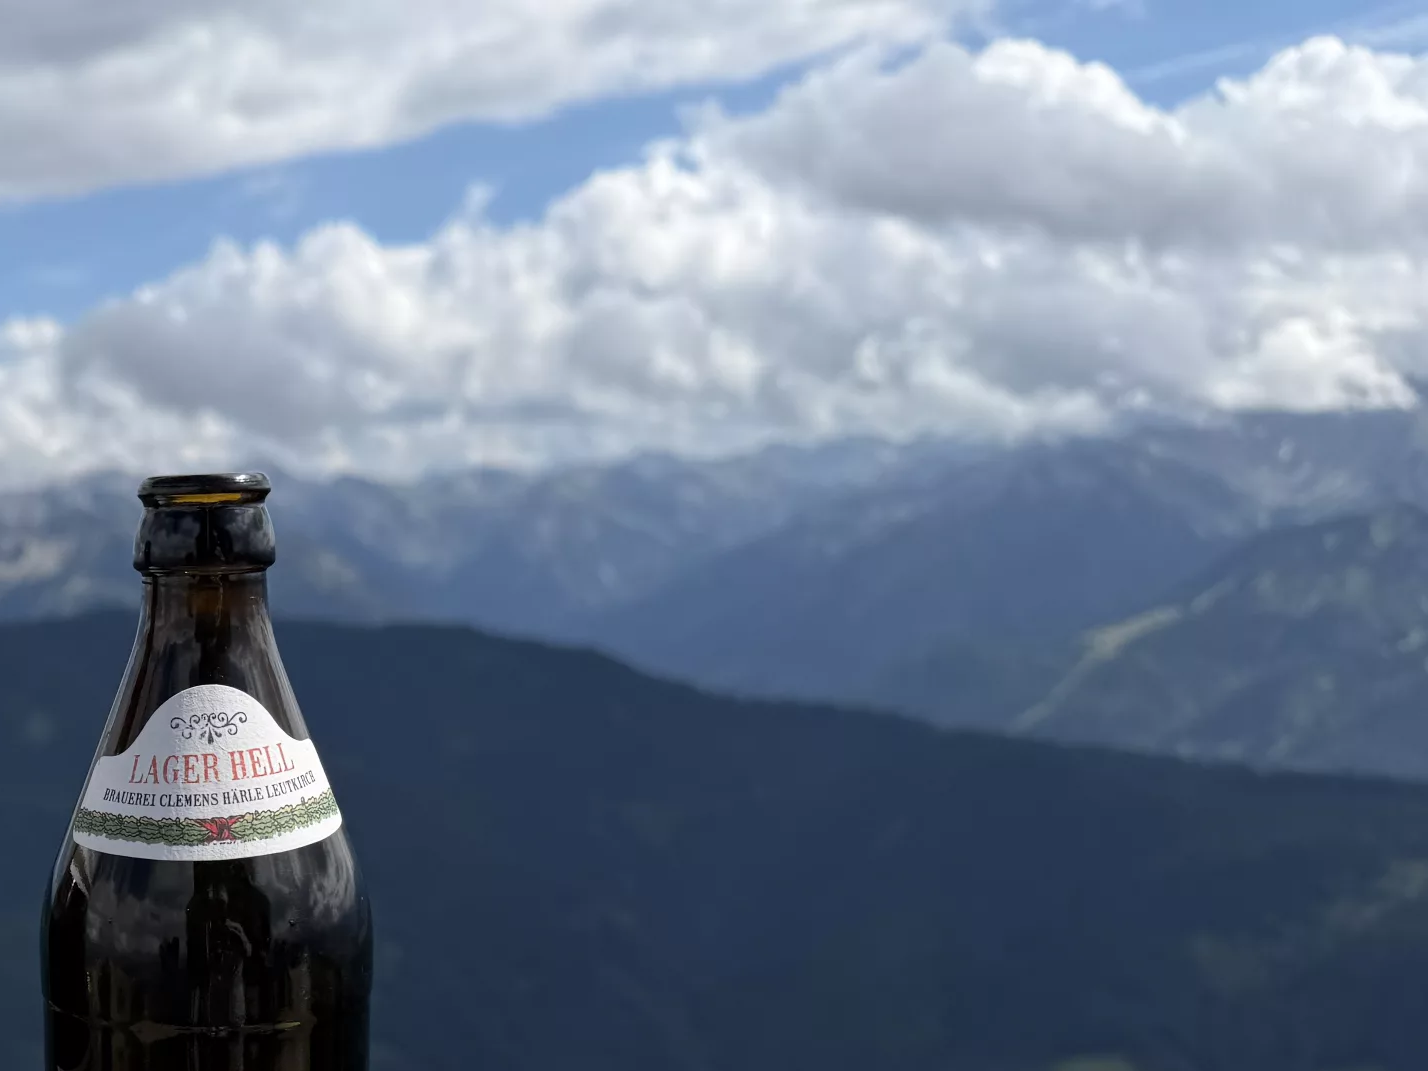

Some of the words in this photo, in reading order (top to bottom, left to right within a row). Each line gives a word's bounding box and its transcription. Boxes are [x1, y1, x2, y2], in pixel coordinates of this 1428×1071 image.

[128, 752, 221, 784] LAGER
[228, 743, 295, 781] HELL
[103, 788, 156, 807] BRAUEREI
[160, 793, 219, 808] CLEMENS
[223, 787, 264, 806] HÄRLE
[266, 770, 316, 799] LEUTKIRCH
